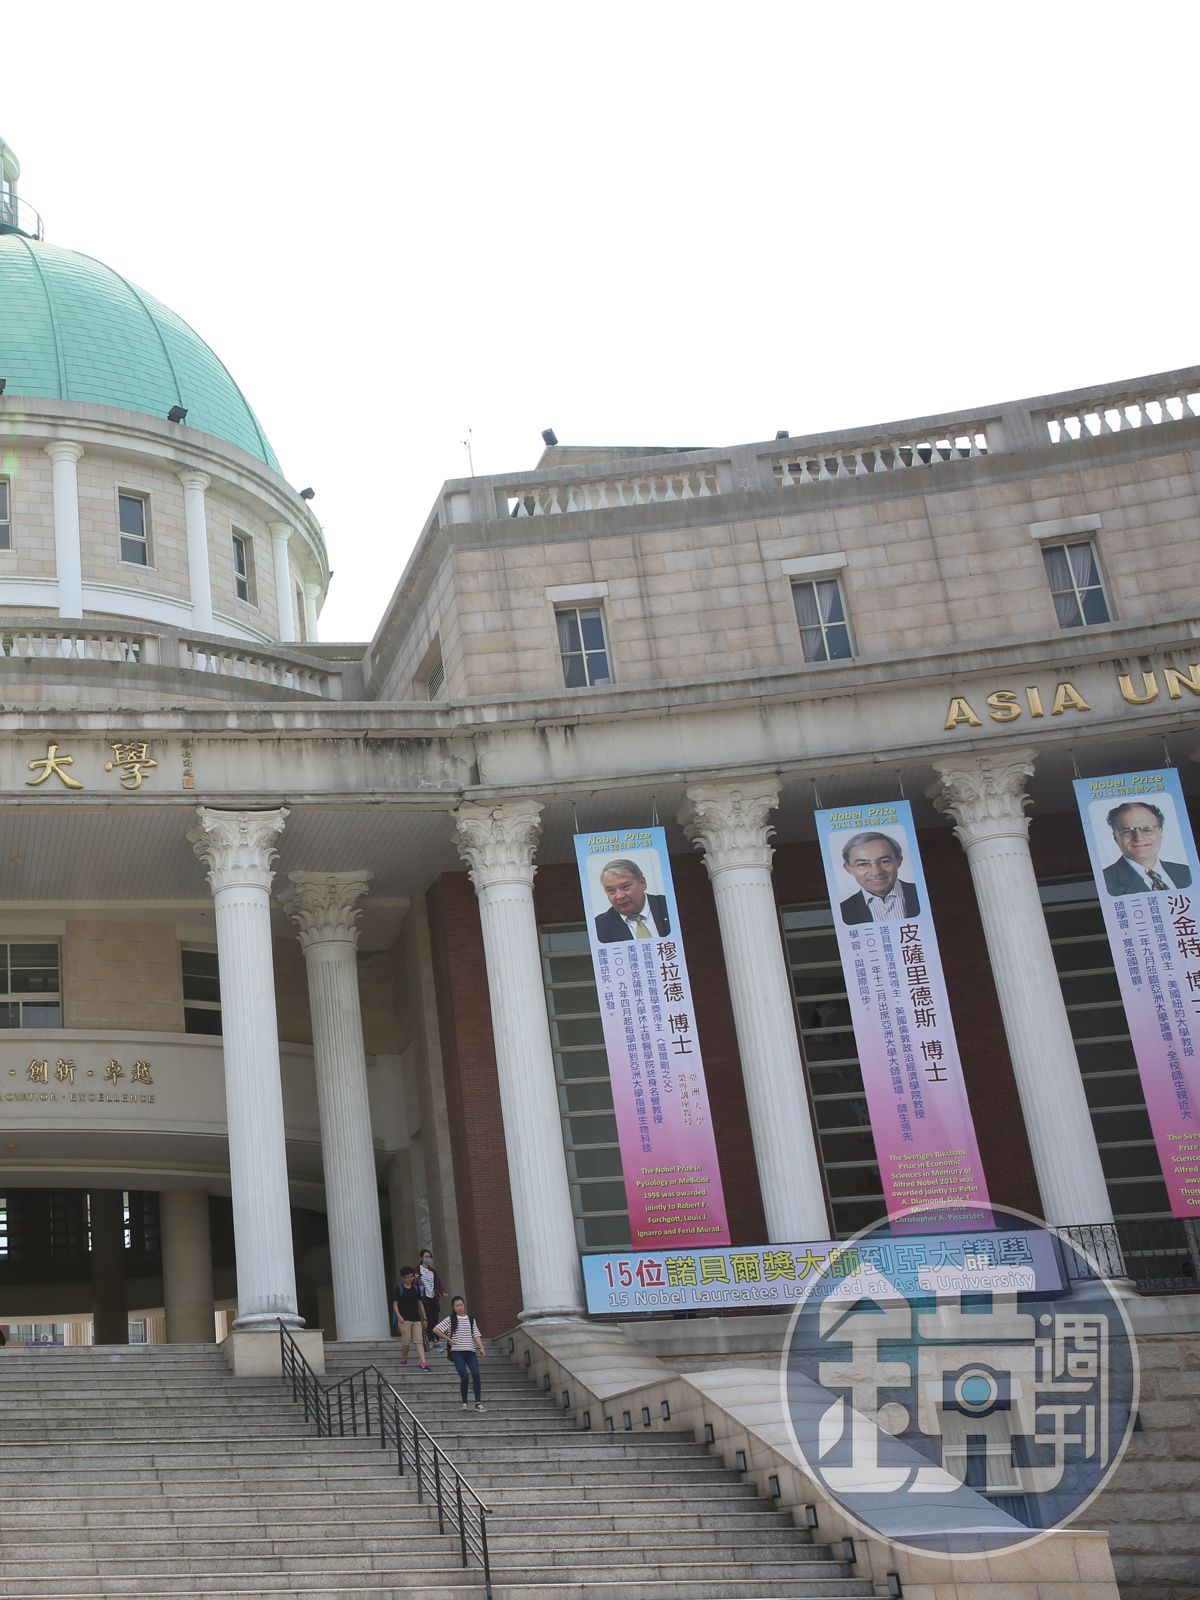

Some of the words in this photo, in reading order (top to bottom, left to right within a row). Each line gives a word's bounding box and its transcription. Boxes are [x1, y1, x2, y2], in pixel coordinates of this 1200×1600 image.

[944, 682, 1091, 730] ASIA
[1088, 779, 1125, 790] Nobel
[1132, 775, 1163, 785] Prize
[830, 811, 862, 821] Nobel
[868, 807, 896, 817] Prize
[588, 835, 619, 846] Nobel
[625, 832, 651, 841] Prize
[656, 941, 685, 1003] 穆拉德
[1168, 894, 1200, 959] 沙金特
[1185, 970, 1200, 1014] 博
[900, 923, 937, 1029] 皮薩里德斯
[920, 1040, 948, 1082] 博士
[668, 1012, 693, 1055] 博士
[70, 1092, 156, 1104] EXCELLENCE
[1174, 1166, 1199, 1174] Alfred
[609, 1292, 629, 1307] 15
[635, 1288, 686, 1306] Nobel
[692, 1284, 779, 1303] Laureates
[784, 1280, 862, 1299] Lectured
[868, 1279, 887, 1294] at
[894, 1276, 932, 1293] Asia
[936, 1270, 1035, 1290] University
